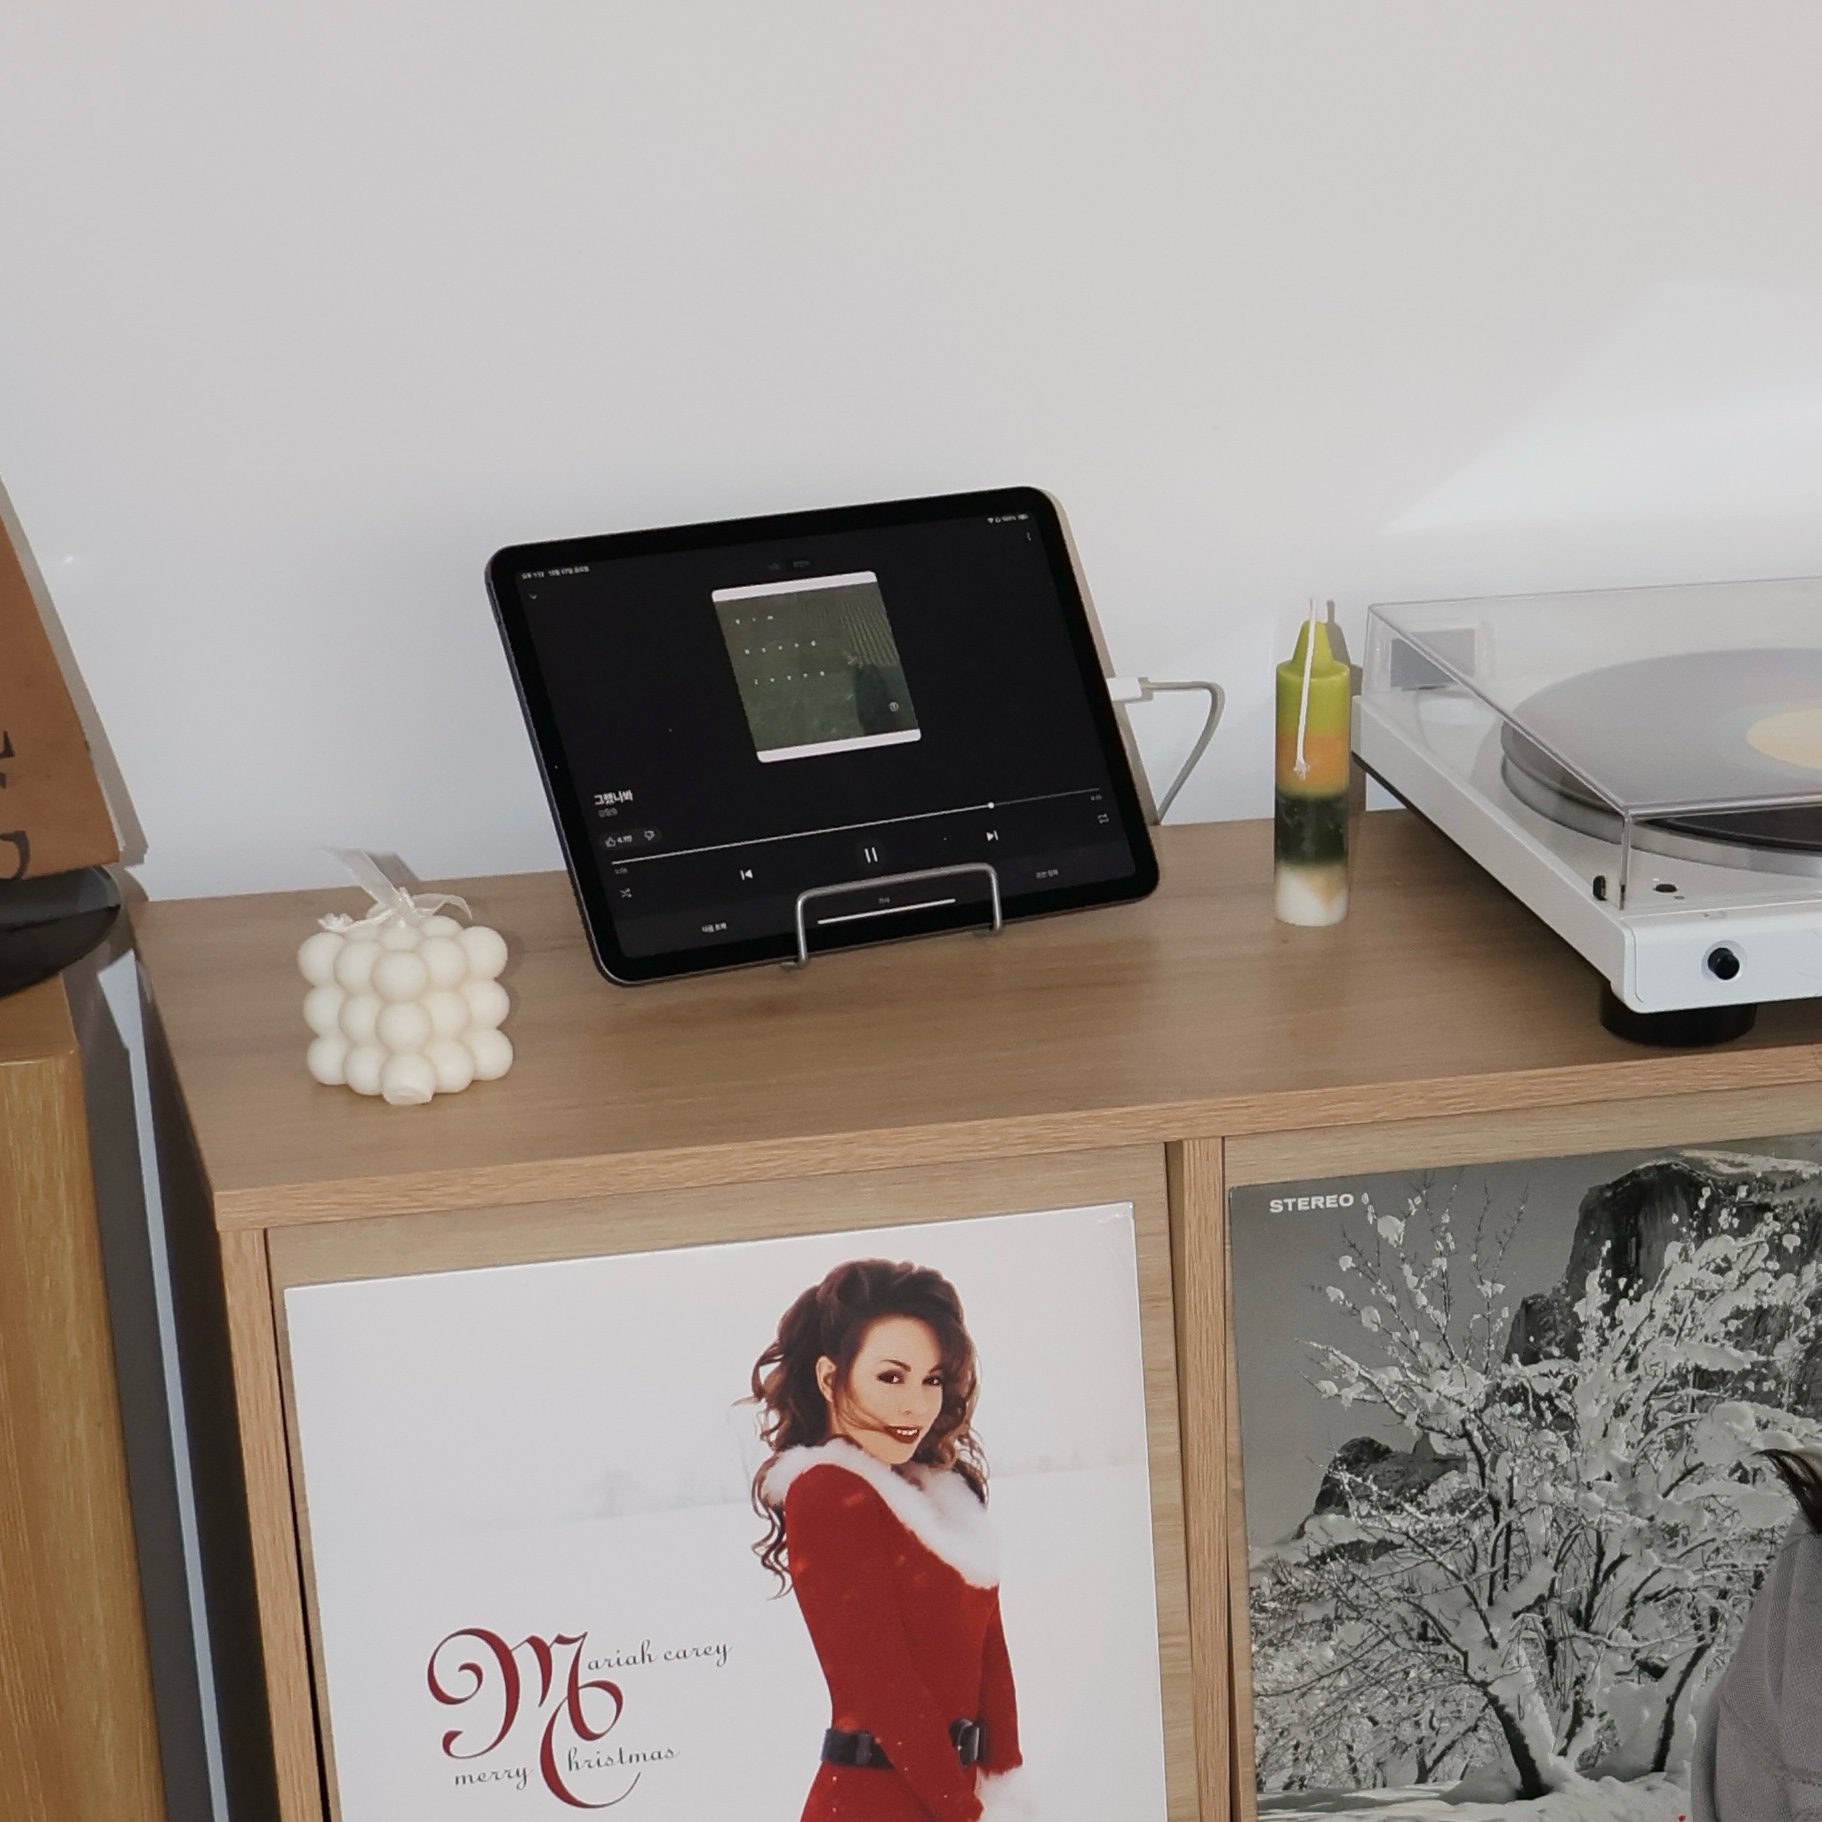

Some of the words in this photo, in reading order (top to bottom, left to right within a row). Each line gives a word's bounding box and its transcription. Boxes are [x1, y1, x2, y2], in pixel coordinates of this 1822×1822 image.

[1269, 1193, 1354, 1213] STEREO
[663, 1642, 733, 1668] carey
[454, 1766, 533, 1791] merry
